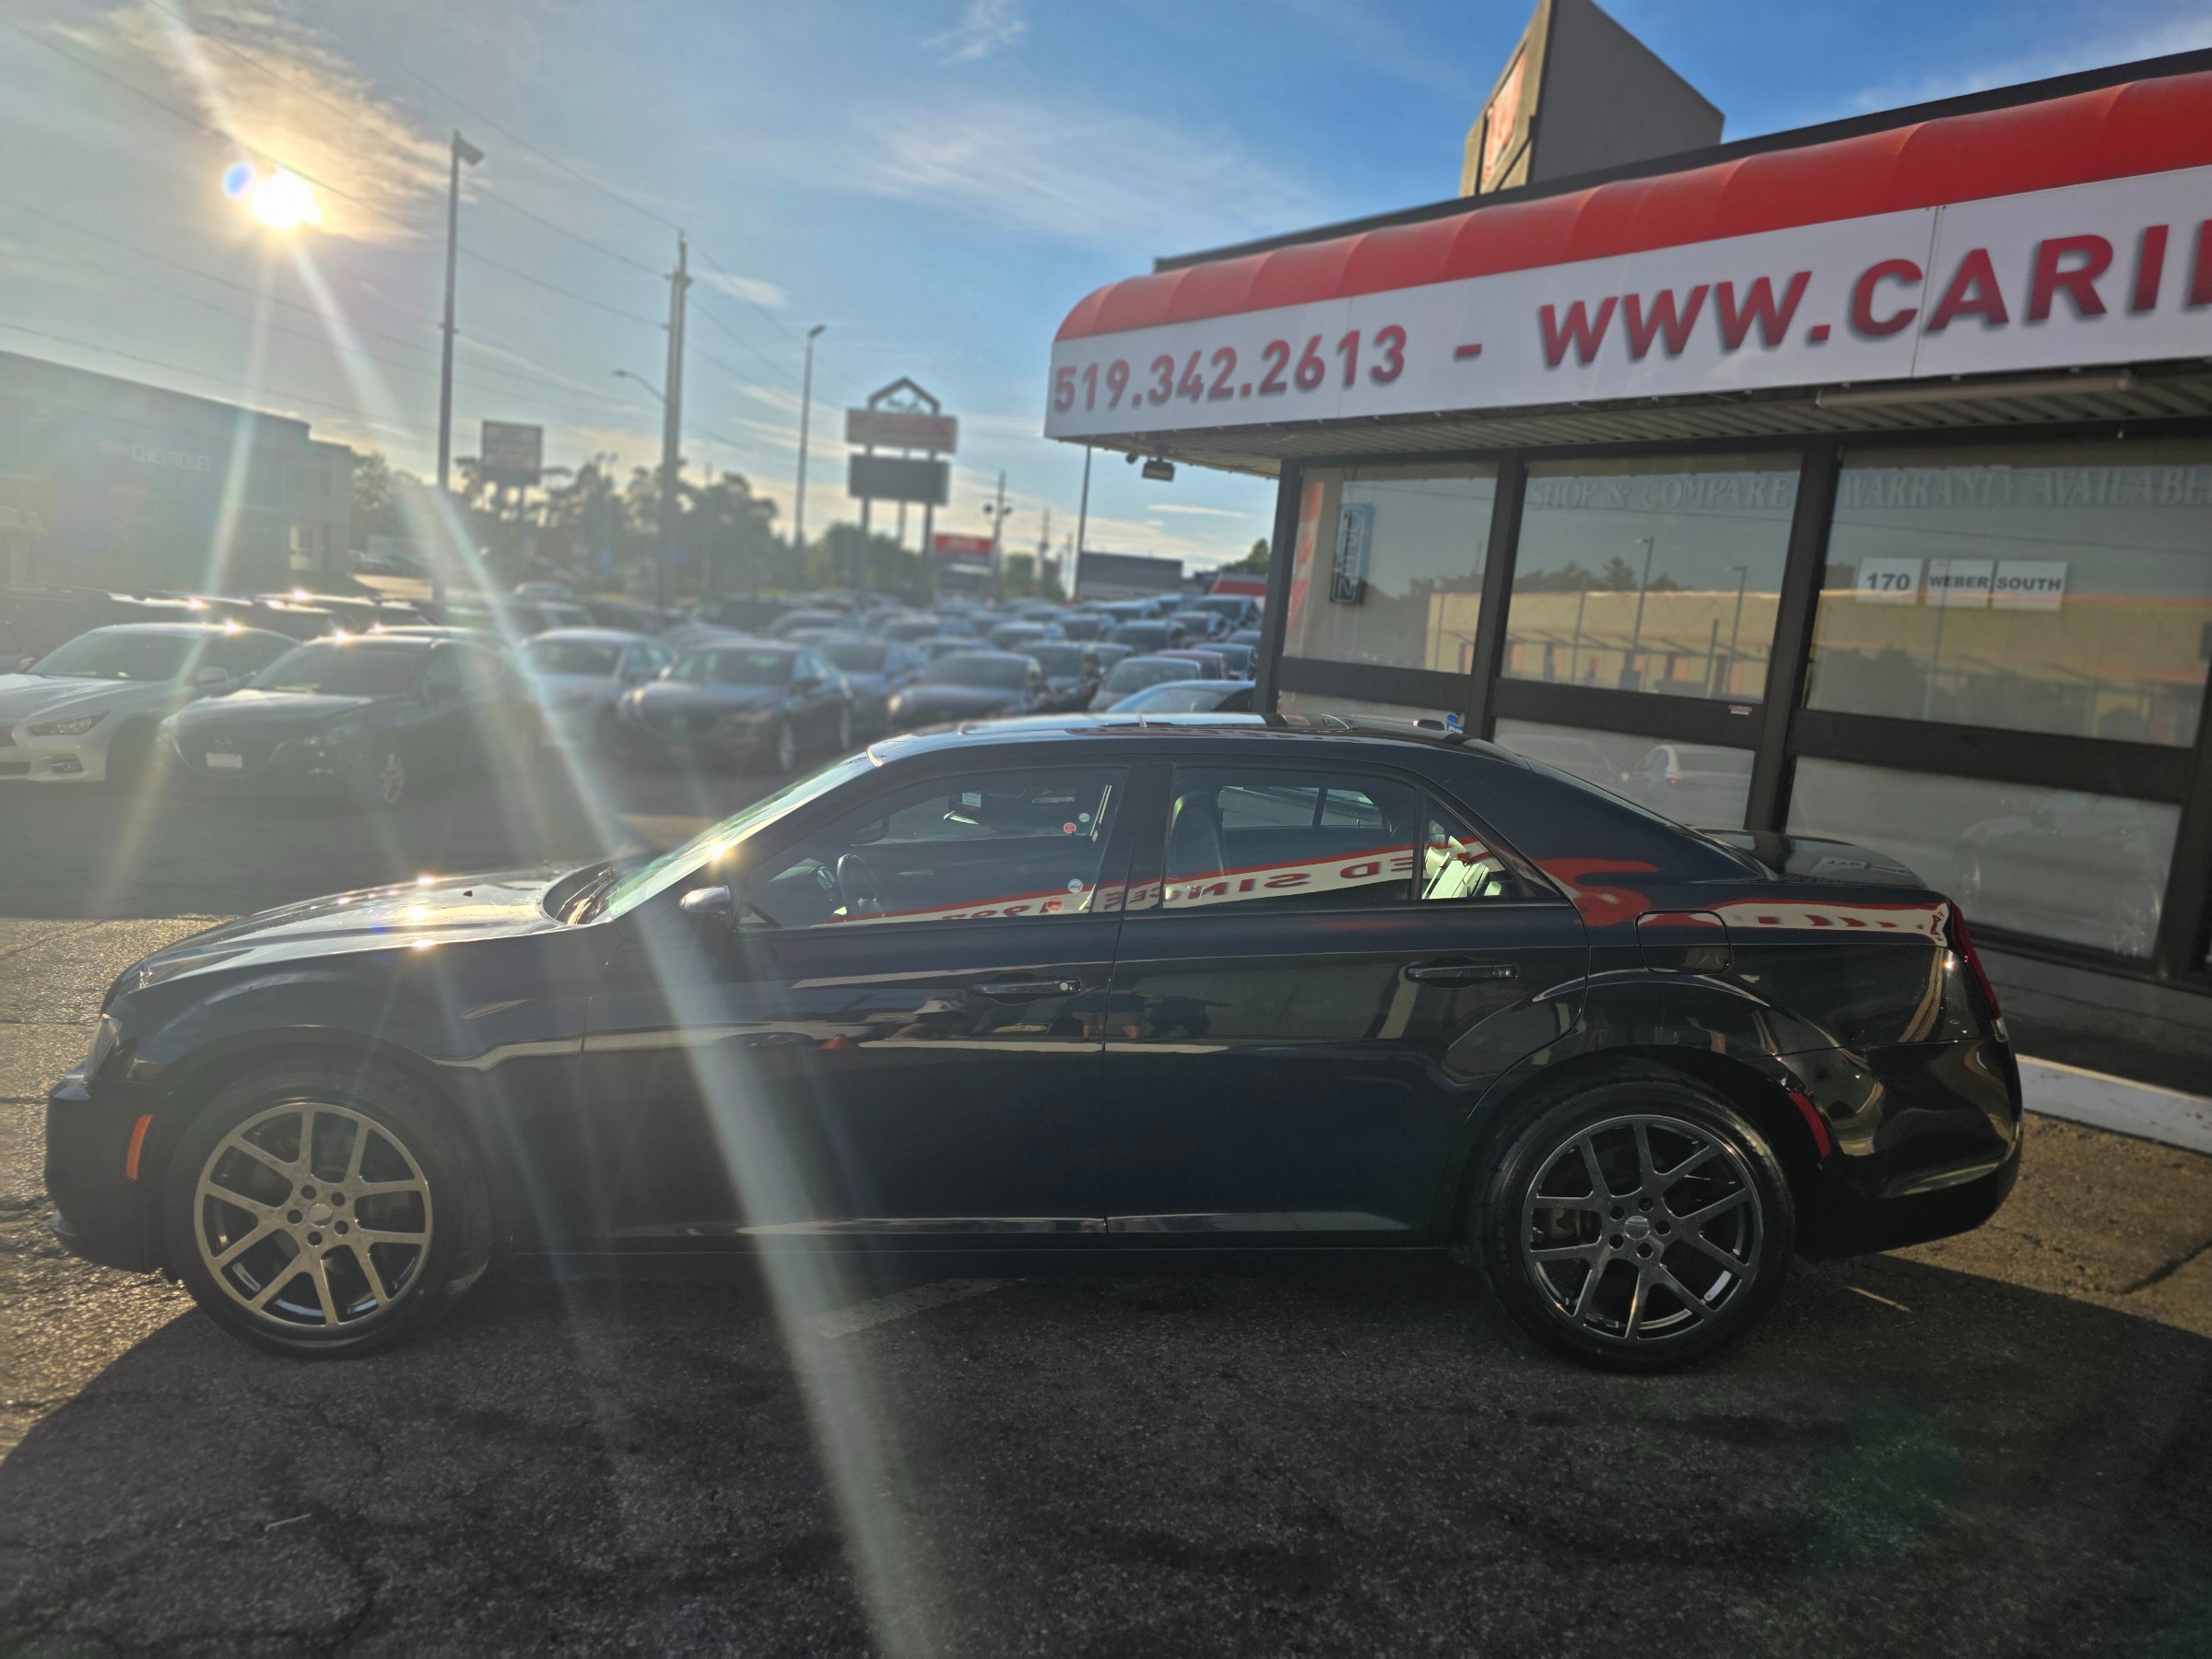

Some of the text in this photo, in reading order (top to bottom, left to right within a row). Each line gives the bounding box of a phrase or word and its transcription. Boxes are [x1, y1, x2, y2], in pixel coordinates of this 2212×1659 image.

[1053, 324, 1407, 414] 519.342.2613
[1531, 480, 1598, 508] SHOP
[1644, 477, 1790, 508] COMPARE
[1842, 467, 2212, 506] WARRANTY AVAILABL
[1866, 572, 2062, 592] 170 WEBER SOUTH
